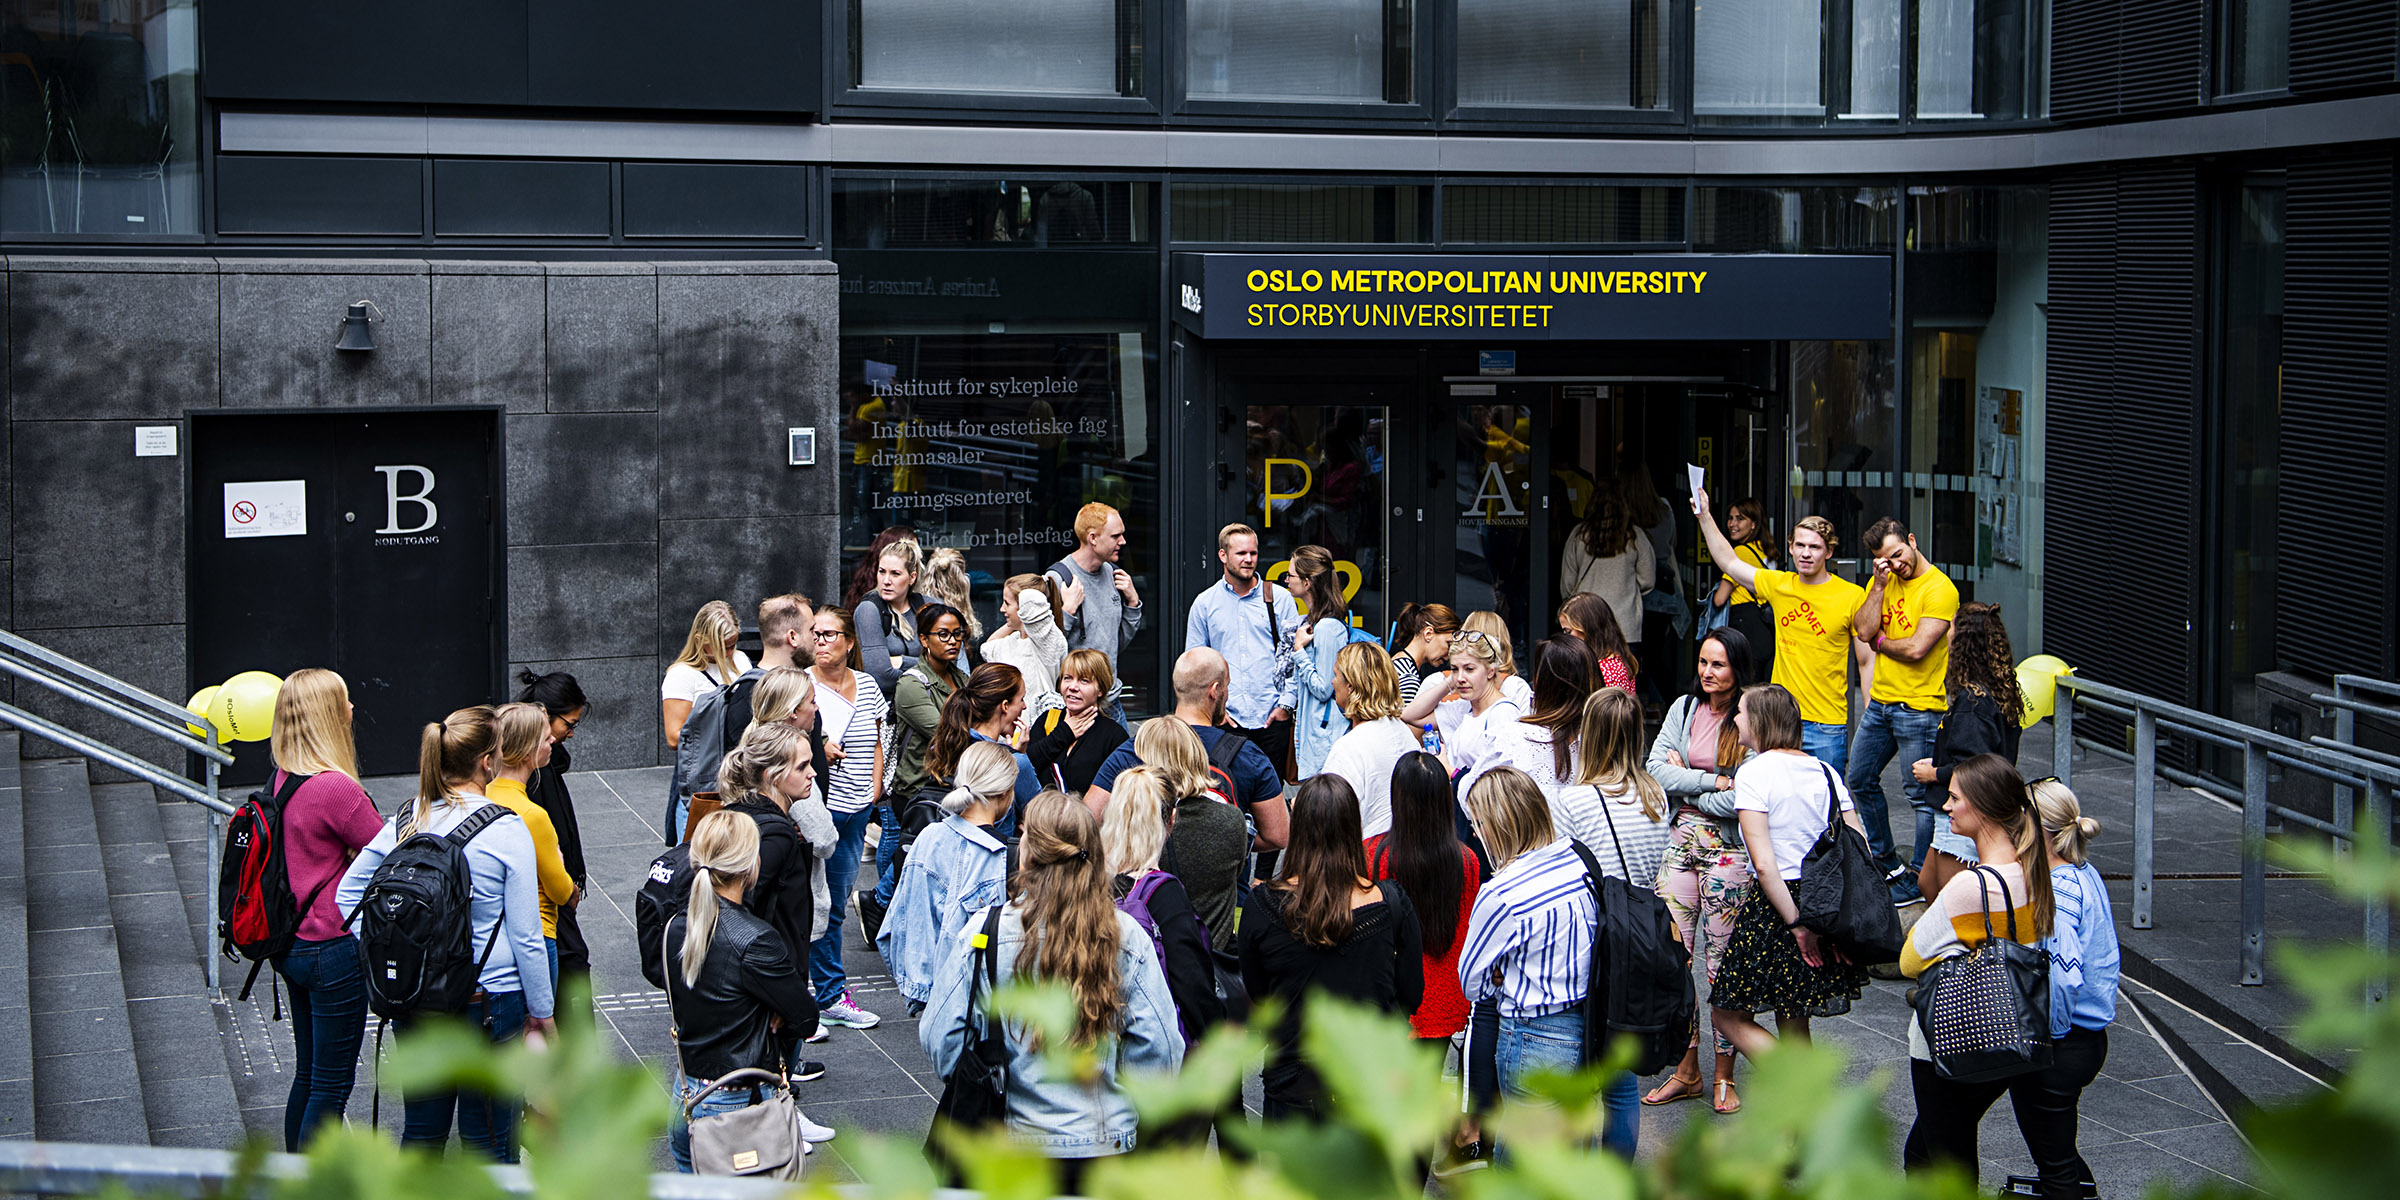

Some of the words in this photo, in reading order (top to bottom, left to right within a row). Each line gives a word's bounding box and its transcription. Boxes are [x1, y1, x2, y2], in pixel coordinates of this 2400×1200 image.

[1247, 269, 1323, 292] OSLO
[1331, 270, 1542, 294] METROPOLITAN
[1550, 271, 1708, 293] UNIVERSITY
[1247, 304, 1554, 328] STORBYUNIVERSITETET
[871, 378, 952, 397] Institutt
[957, 378, 985, 395] for
[989, 376, 1078, 398] sykepleie
[871, 420, 952, 439] Institutt
[957, 418, 985, 437] for
[989, 416, 1073, 436] estetiske
[1078, 416, 1107, 436] fag
[871, 447, 985, 466] dramasaler
[375, 465, 438, 534] B
[872, 487, 1033, 511] Læringssenteret
[1264, 458, 1313, 528] P
[1462, 461, 1524, 516] A
[1458, 518, 1528, 526] HOVEDINNGANG
[375, 536, 440, 546] NØDUTGANG
[962, 528, 990, 546] for
[994, 526, 1073, 546] helsefag
